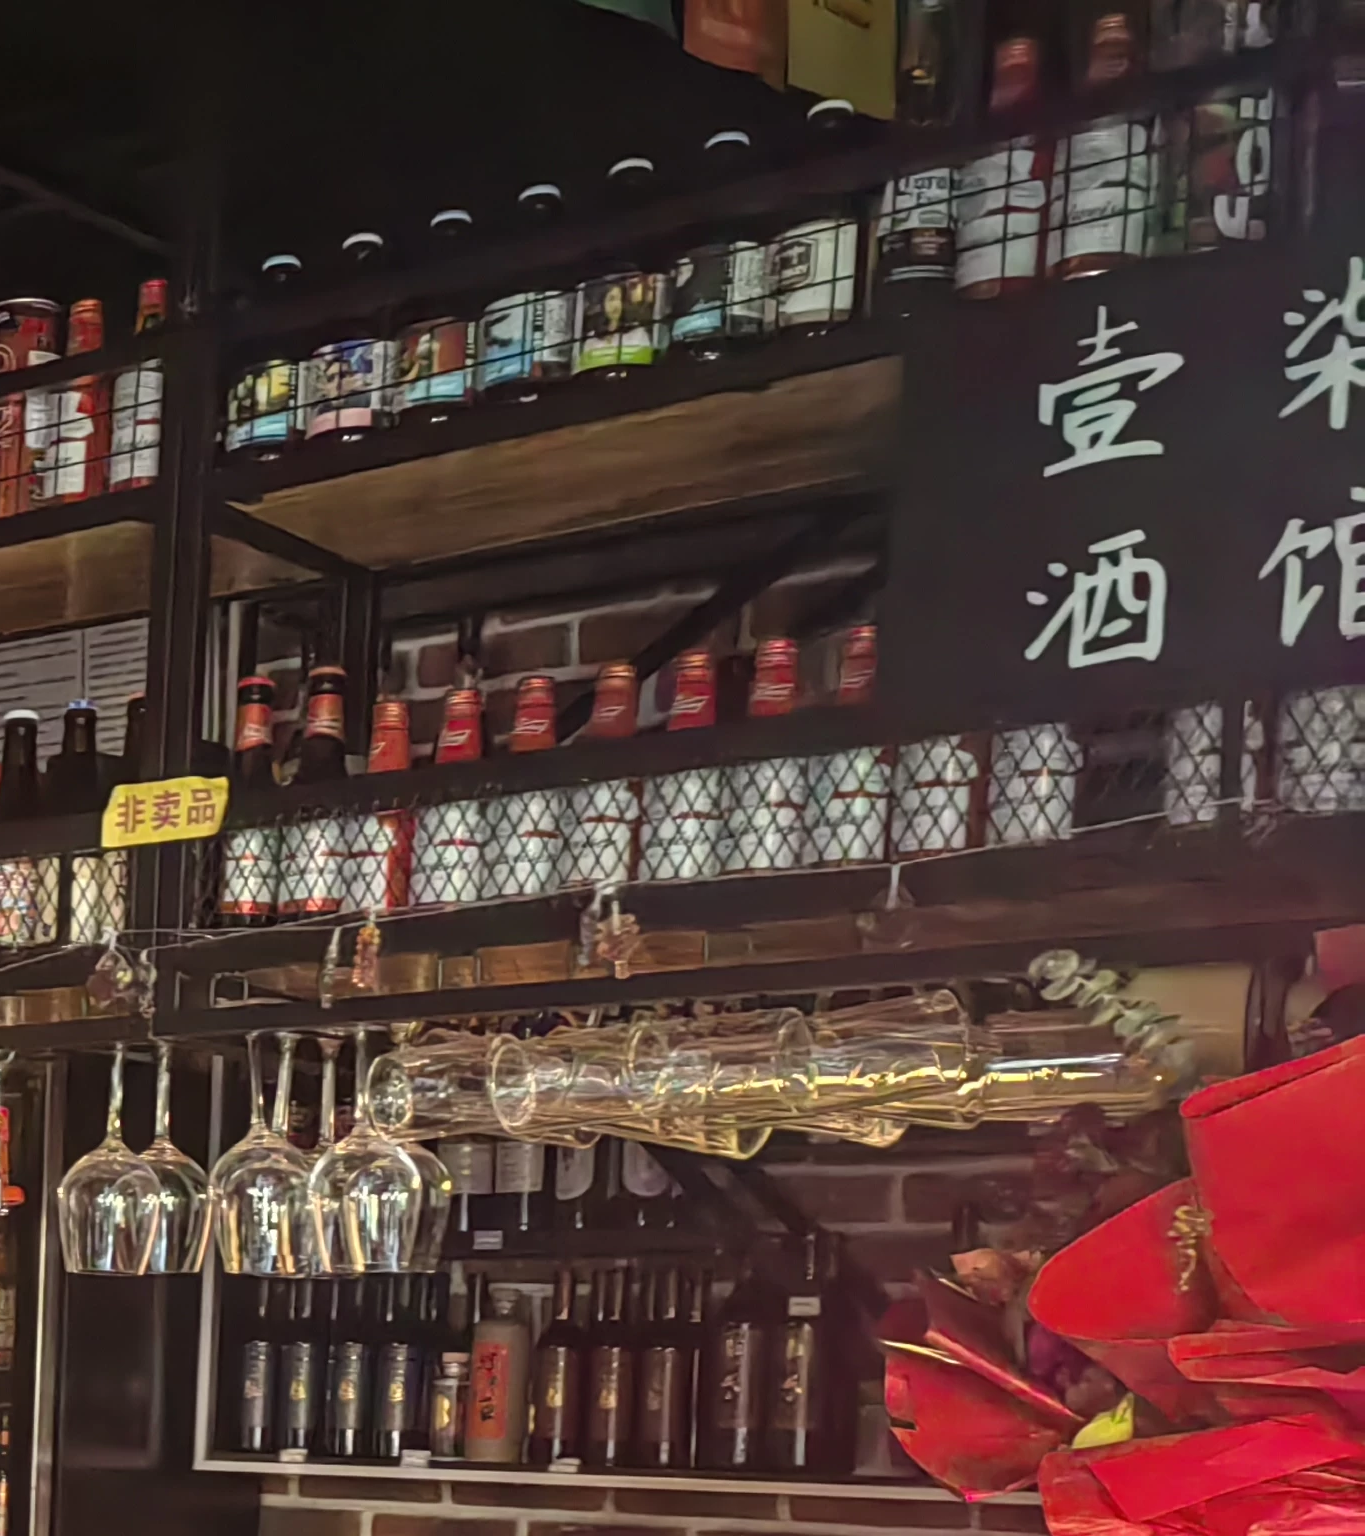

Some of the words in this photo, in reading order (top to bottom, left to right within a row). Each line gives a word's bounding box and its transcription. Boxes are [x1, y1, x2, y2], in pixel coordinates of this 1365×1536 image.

[1037, 256, 1365, 477] 壹柒
[1024, 486, 1365, 668] 酒馆
[115, 788, 216, 833] 非卖品
